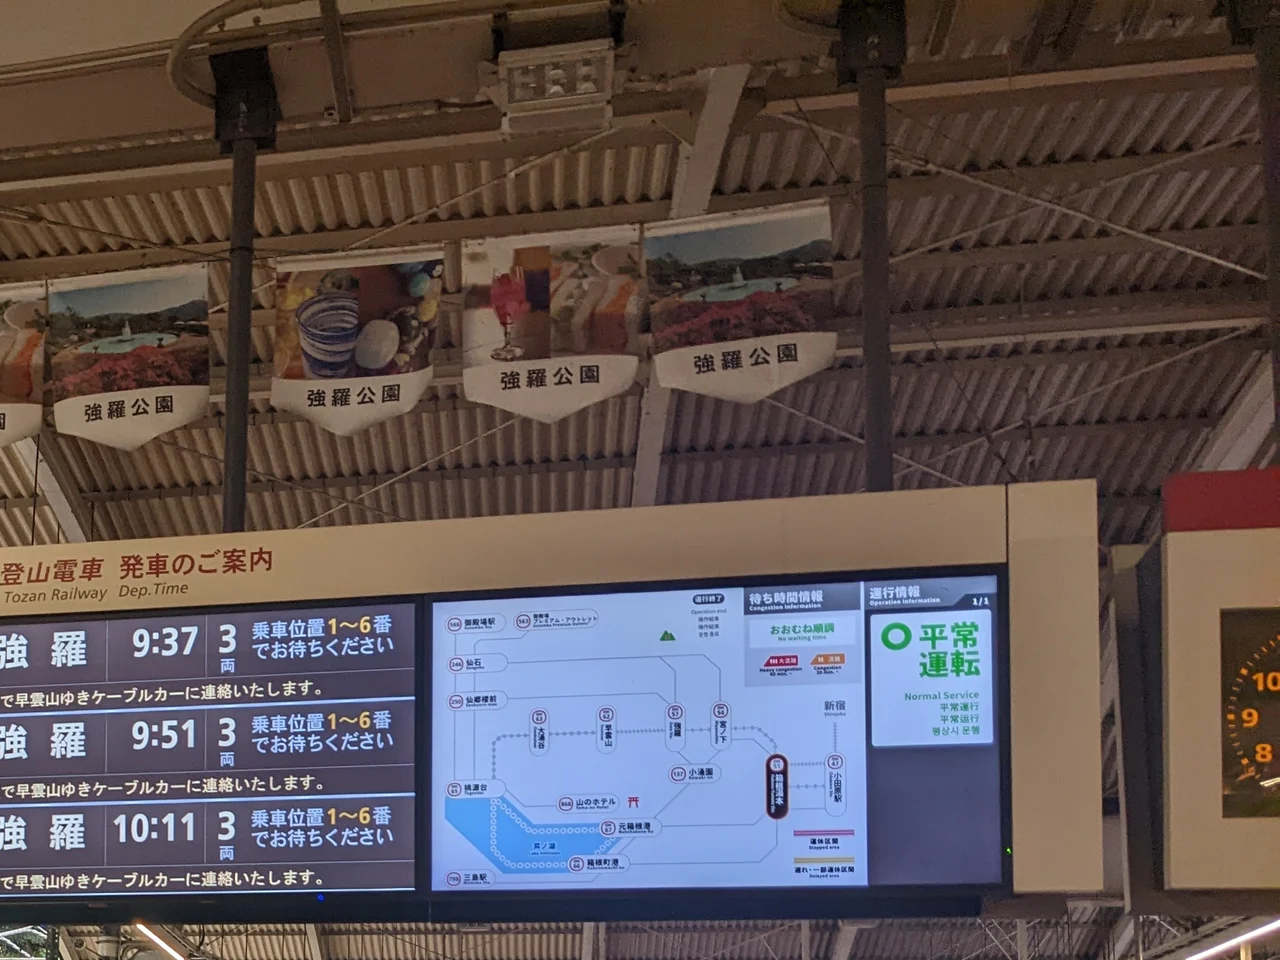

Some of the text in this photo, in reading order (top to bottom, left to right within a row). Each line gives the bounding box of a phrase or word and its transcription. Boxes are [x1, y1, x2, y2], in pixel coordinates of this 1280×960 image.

[693, 343, 800, 375] 強羅公園
[500, 364, 601, 391] 強羅公園
[306, 382, 402, 409] 強羅公園
[84, 395, 174, 423] 強羅公園
[120, 547, 273, 579] 発車のご案内
[4, 589, 47, 604] Tozan
[51, 586, 108, 603] Railway
[119, 581, 189, 599] Dep.Time
[749, 590, 823, 605] 待ち時間情報
[870, 586, 920, 599] 運行情報
[973, 597, 989, 606] 1/1
[218, 624, 237, 653] 3
[770, 623, 835, 636] おおむね順調
[919, 621, 979, 650] 平常
[132, 626, 199, 658] 9:37
[251, 636, 395, 661] でお待ちください
[220, 658, 236, 674] 両
[466, 658, 482, 667] 仙石
[919, 649, 981, 678] 運転
[1252, 671, 1280, 692] 10
[824, 700, 846, 712] 新宿
[905, 691, 979, 701] Normal Service
[940, 702, 979, 712] 平常運行
[1241, 708, 1259, 727] 9
[131, 719, 196, 751] 9:51
[218, 717, 237, 747] 3
[251, 732, 394, 755] でお待ちください
[1255, 743, 1273, 763] 8
[220, 752, 235, 767] 両
[576, 798, 616, 807] 山のホテル
[113, 811, 195, 844] 10:11
[217, 811, 236, 840] 3
[250, 827, 394, 849] でお待ちください
[219, 846, 235, 861] 両
